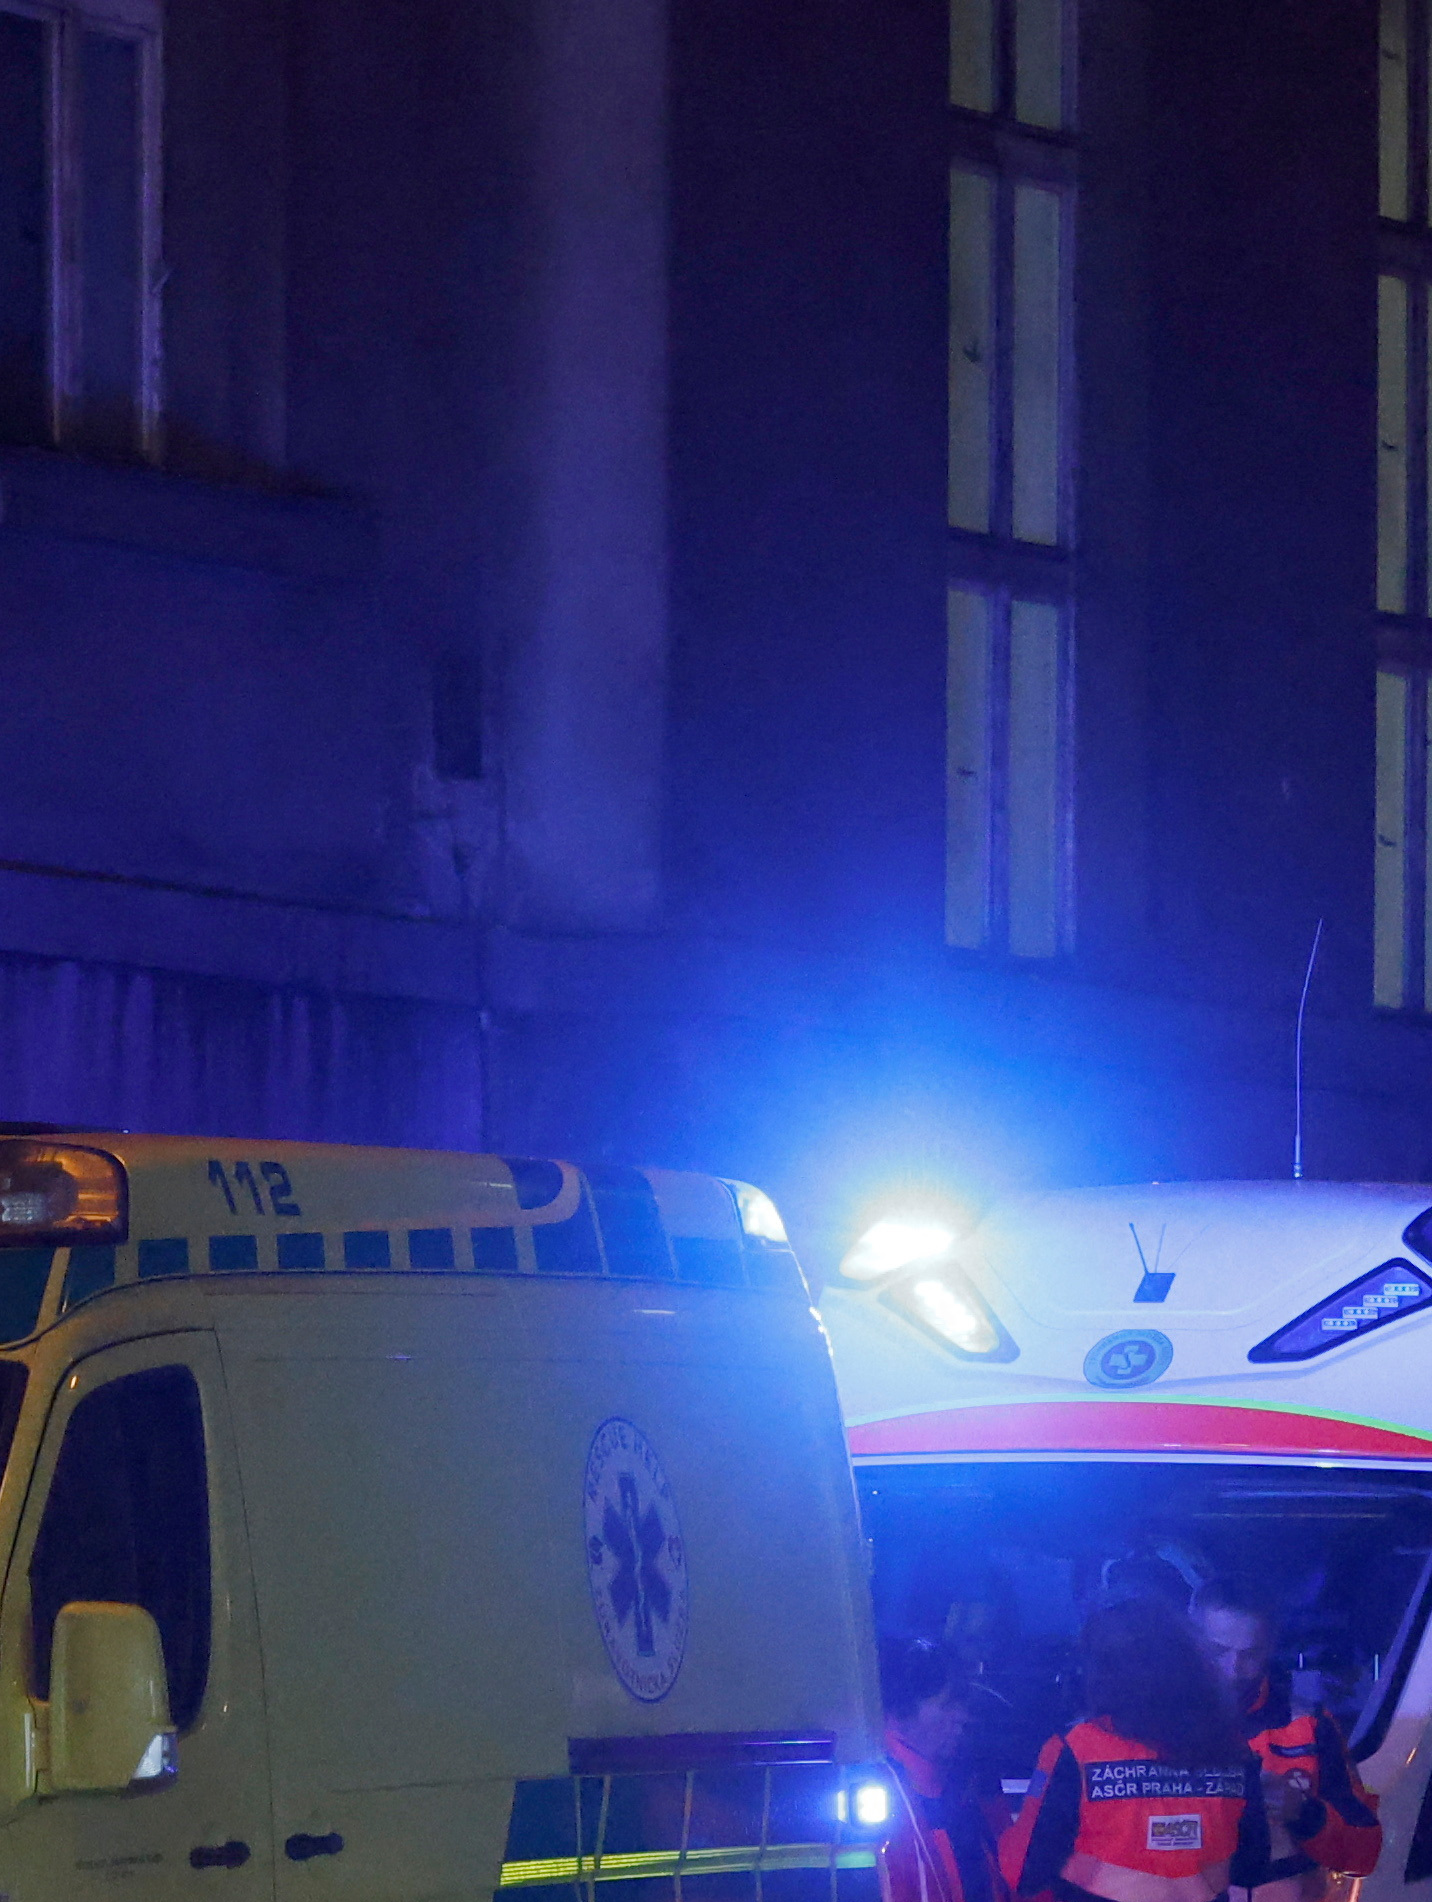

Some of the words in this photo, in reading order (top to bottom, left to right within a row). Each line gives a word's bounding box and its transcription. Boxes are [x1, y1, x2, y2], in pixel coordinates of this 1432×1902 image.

[207, 1160, 301, 1216] 112
[1091, 1779, 1138, 1799] ASČR
[1142, 1781, 1193, 1795] PRAHA
